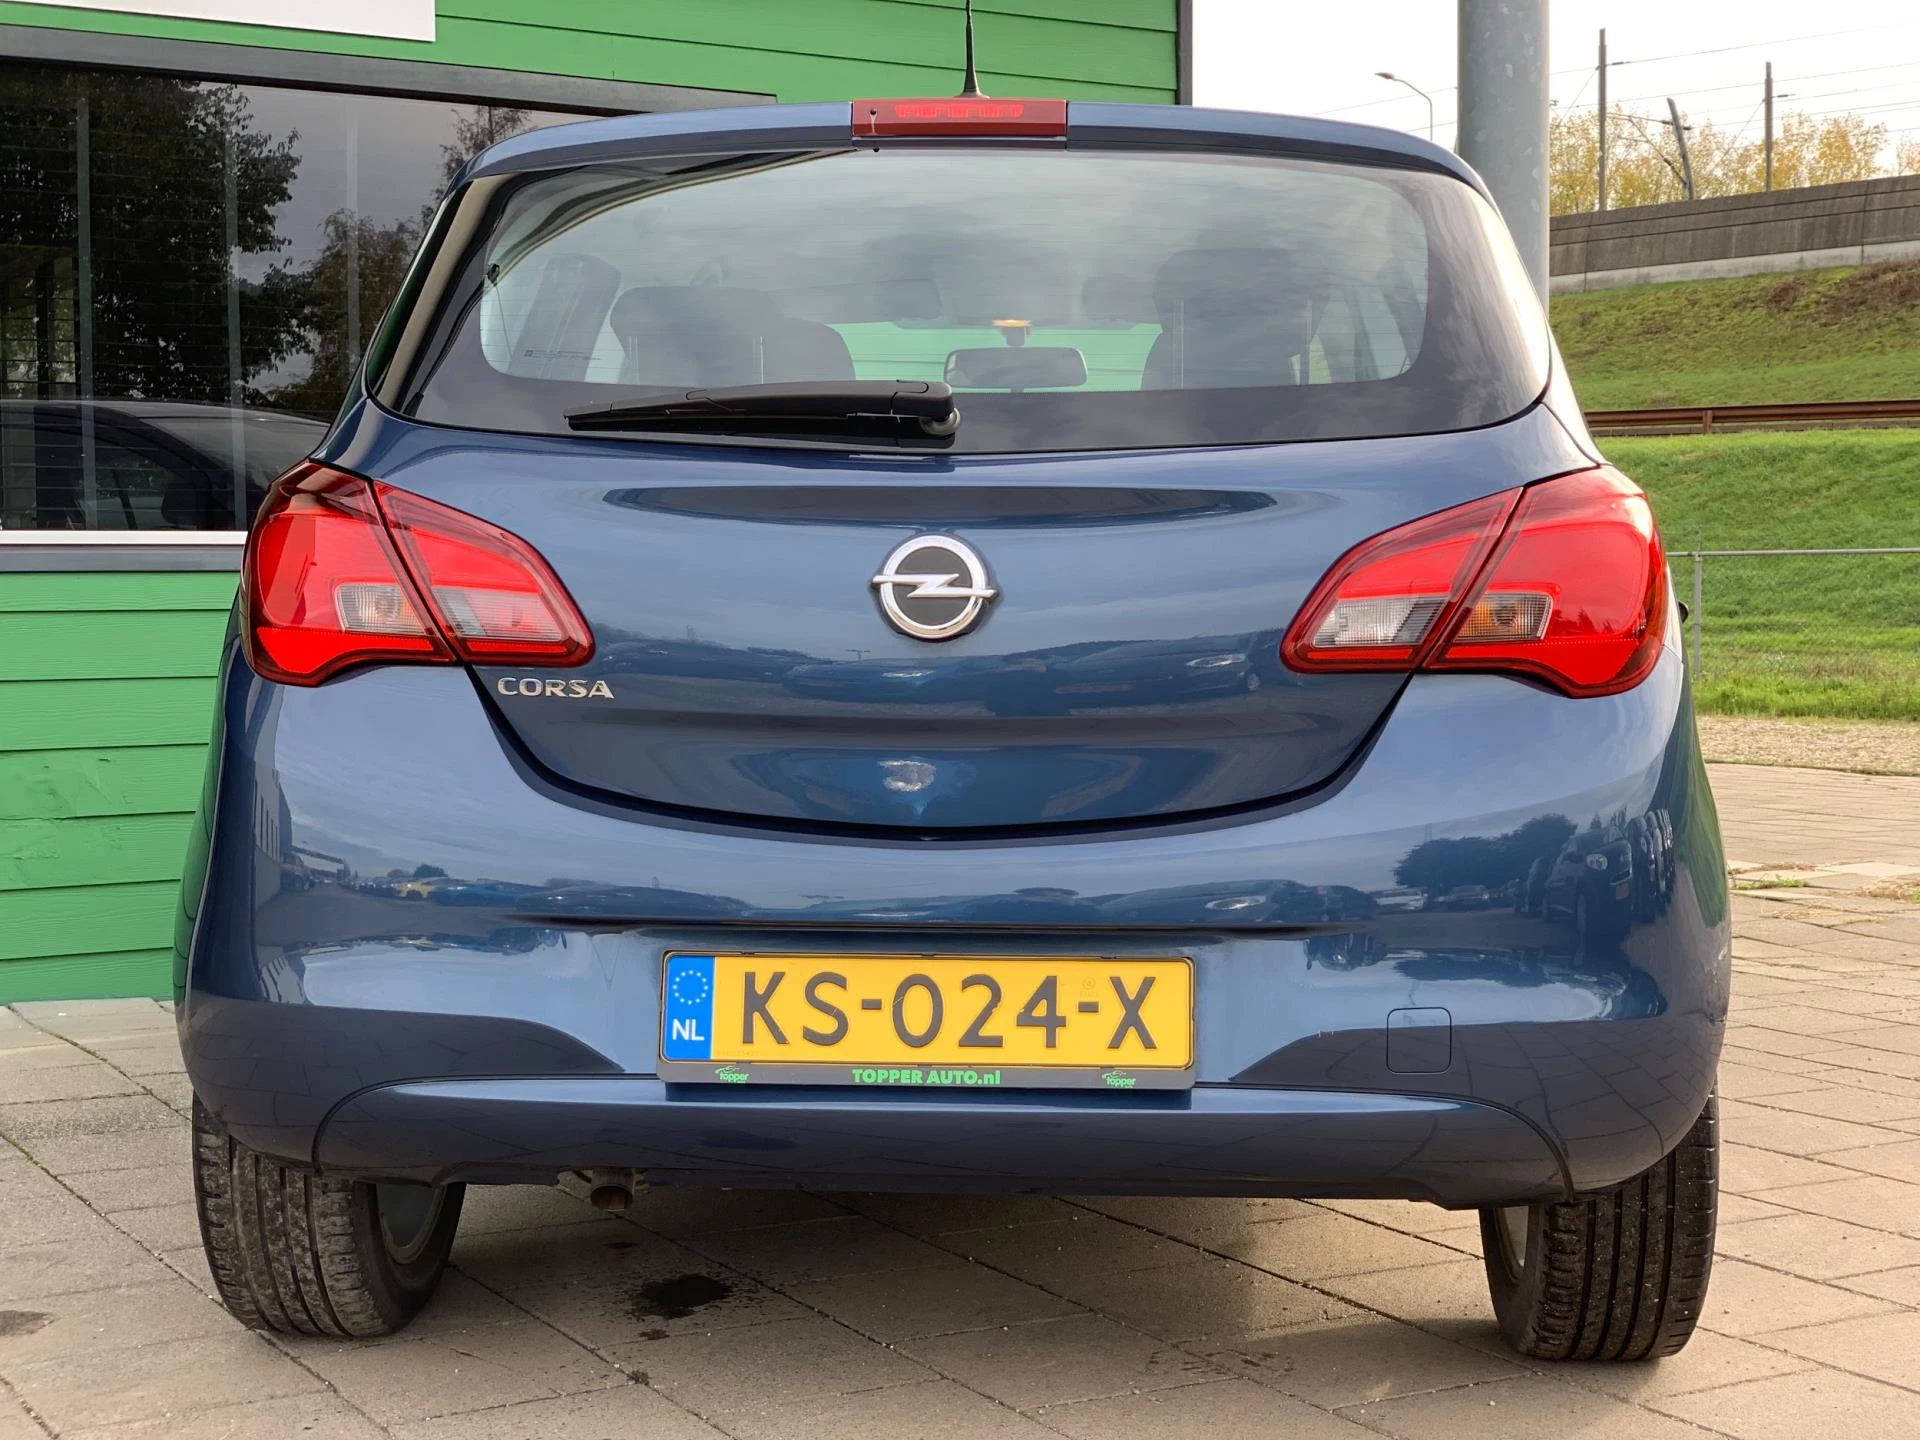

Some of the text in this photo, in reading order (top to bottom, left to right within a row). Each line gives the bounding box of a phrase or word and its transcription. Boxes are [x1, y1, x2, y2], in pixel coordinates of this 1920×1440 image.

[497, 677, 615, 699] CORSA
[742, 971, 1157, 1050] KS-024-X
[672, 1018, 705, 1041] NL
[852, 1069, 1001, 1085] TOPPER AUTO.nl
